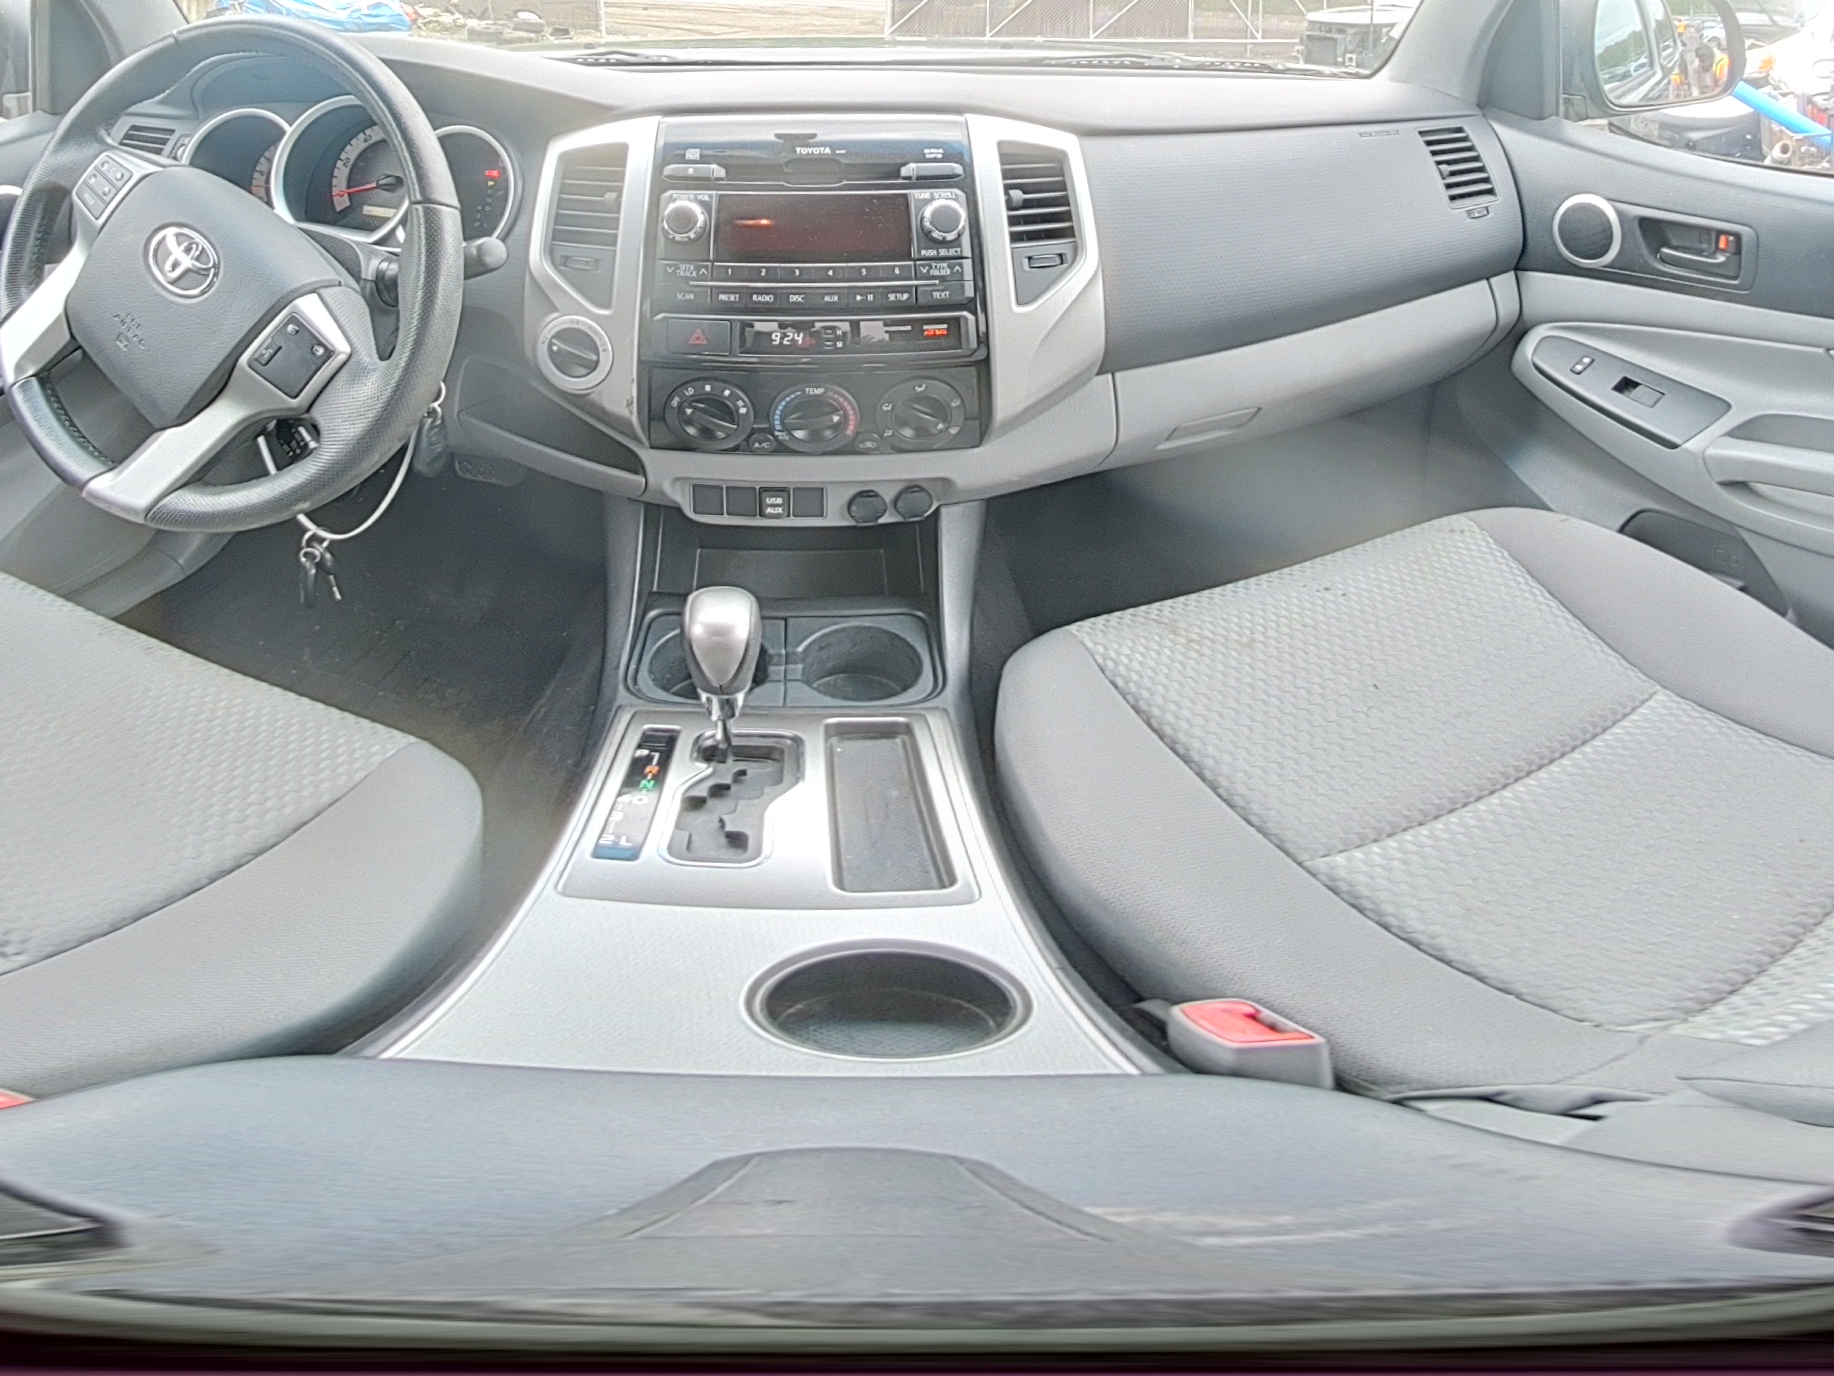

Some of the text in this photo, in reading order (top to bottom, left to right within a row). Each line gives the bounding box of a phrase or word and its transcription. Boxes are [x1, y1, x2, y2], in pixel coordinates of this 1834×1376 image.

[795, 147, 831, 155] TOYOTA
[938, 247, 961, 255] SELECT
[760, 268, 766, 276] 2
[894, 266, 900, 275] 6
[676, 292, 695, 300] SCAN
[718, 293, 740, 301] PRESET
[752, 294, 774, 302] RADIO
[789, 294, 805, 302] DISC
[824, 294, 839, 302] AUX
[887, 293, 909, 301] SETUP
[932, 291, 950, 299] TEXT
[771, 331, 804, 345] 9:24
[805, 387, 825, 395] TEMP
[753, 441, 770, 449] A/C
[766, 497, 783, 505] USB
[766, 506, 784, 514] AUX
[634, 749, 650, 757] P
[598, 833, 632, 846] 2 L
